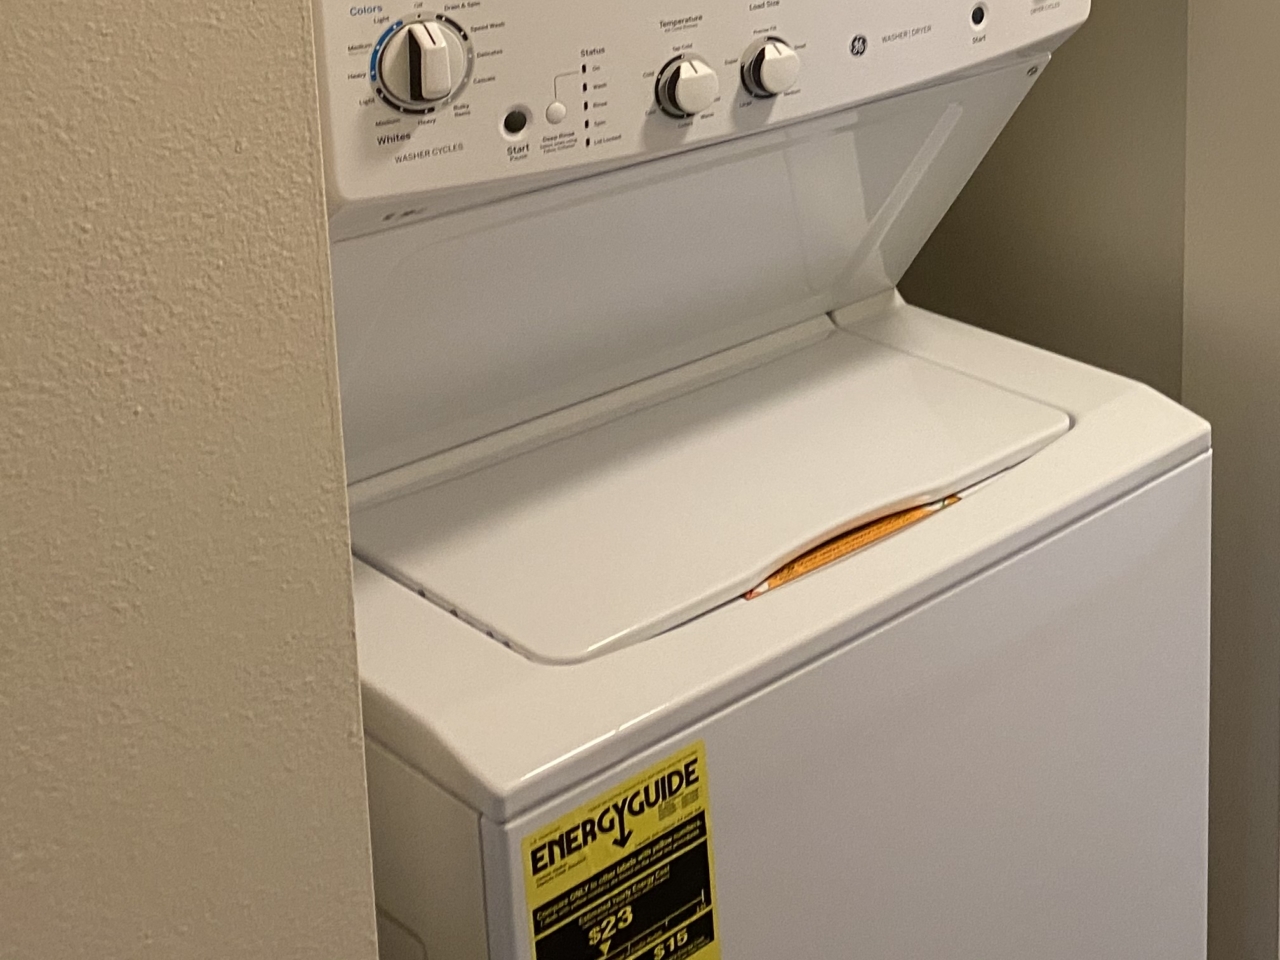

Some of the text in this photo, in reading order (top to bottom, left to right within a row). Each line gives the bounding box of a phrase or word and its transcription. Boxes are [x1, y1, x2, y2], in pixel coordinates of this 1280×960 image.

[349, 5, 383, 17] Colors
[444, 3, 460, 12] Drain
[749, 0, 780, 11] Load Size
[373, 15, 390, 25] Light
[659, 15, 703, 29] Temperature
[470, 23, 489, 33] Speed
[881, 29, 908, 43] WASHER
[911, 25, 932, 37] DRYER
[972, 35, 987, 45] Start
[347, 43, 372, 52] Medium
[580, 47, 605, 58] Status
[476, 49, 503, 59] Delicates
[347, 72, 367, 81] Heavy
[359, 97, 375, 106] Light
[417, 118, 436, 126] Heavy
[376, 132, 411, 146] Whites
[394, 143, 464, 164] WASHER CYCLES
[507, 143, 530, 156] Start
[530, 757, 700, 876] ENERGYGUIDE
[569, 884, 590, 901] ONLY
[598, 869, 616, 885] other
[616, 857, 637, 875] labels
[632, 876, 654, 893] Energy
[588, 905, 634, 946] $23
[654, 928, 688, 960] $15
